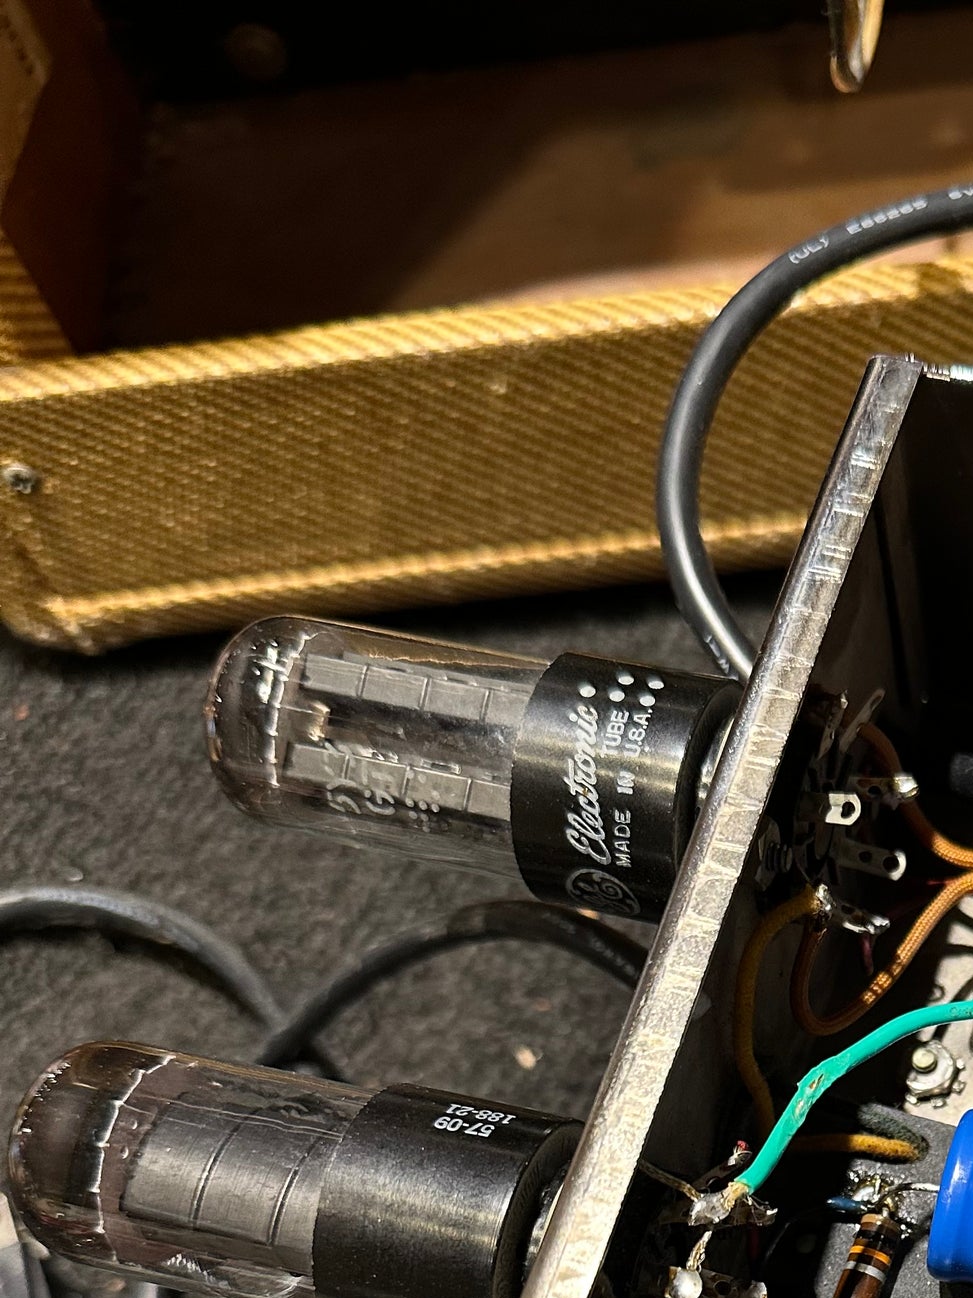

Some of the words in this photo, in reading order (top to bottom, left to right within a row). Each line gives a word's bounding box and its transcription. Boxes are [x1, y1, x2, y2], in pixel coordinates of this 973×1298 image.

[600, 710, 629, 758] TUBE
[565, 704, 611, 866] Electronic
[616, 770, 635, 795] IN
[613, 809, 632, 868] MADE
[433, 1116, 495, 1138] 57-09
[446, 1103, 516, 1124] 188-21
